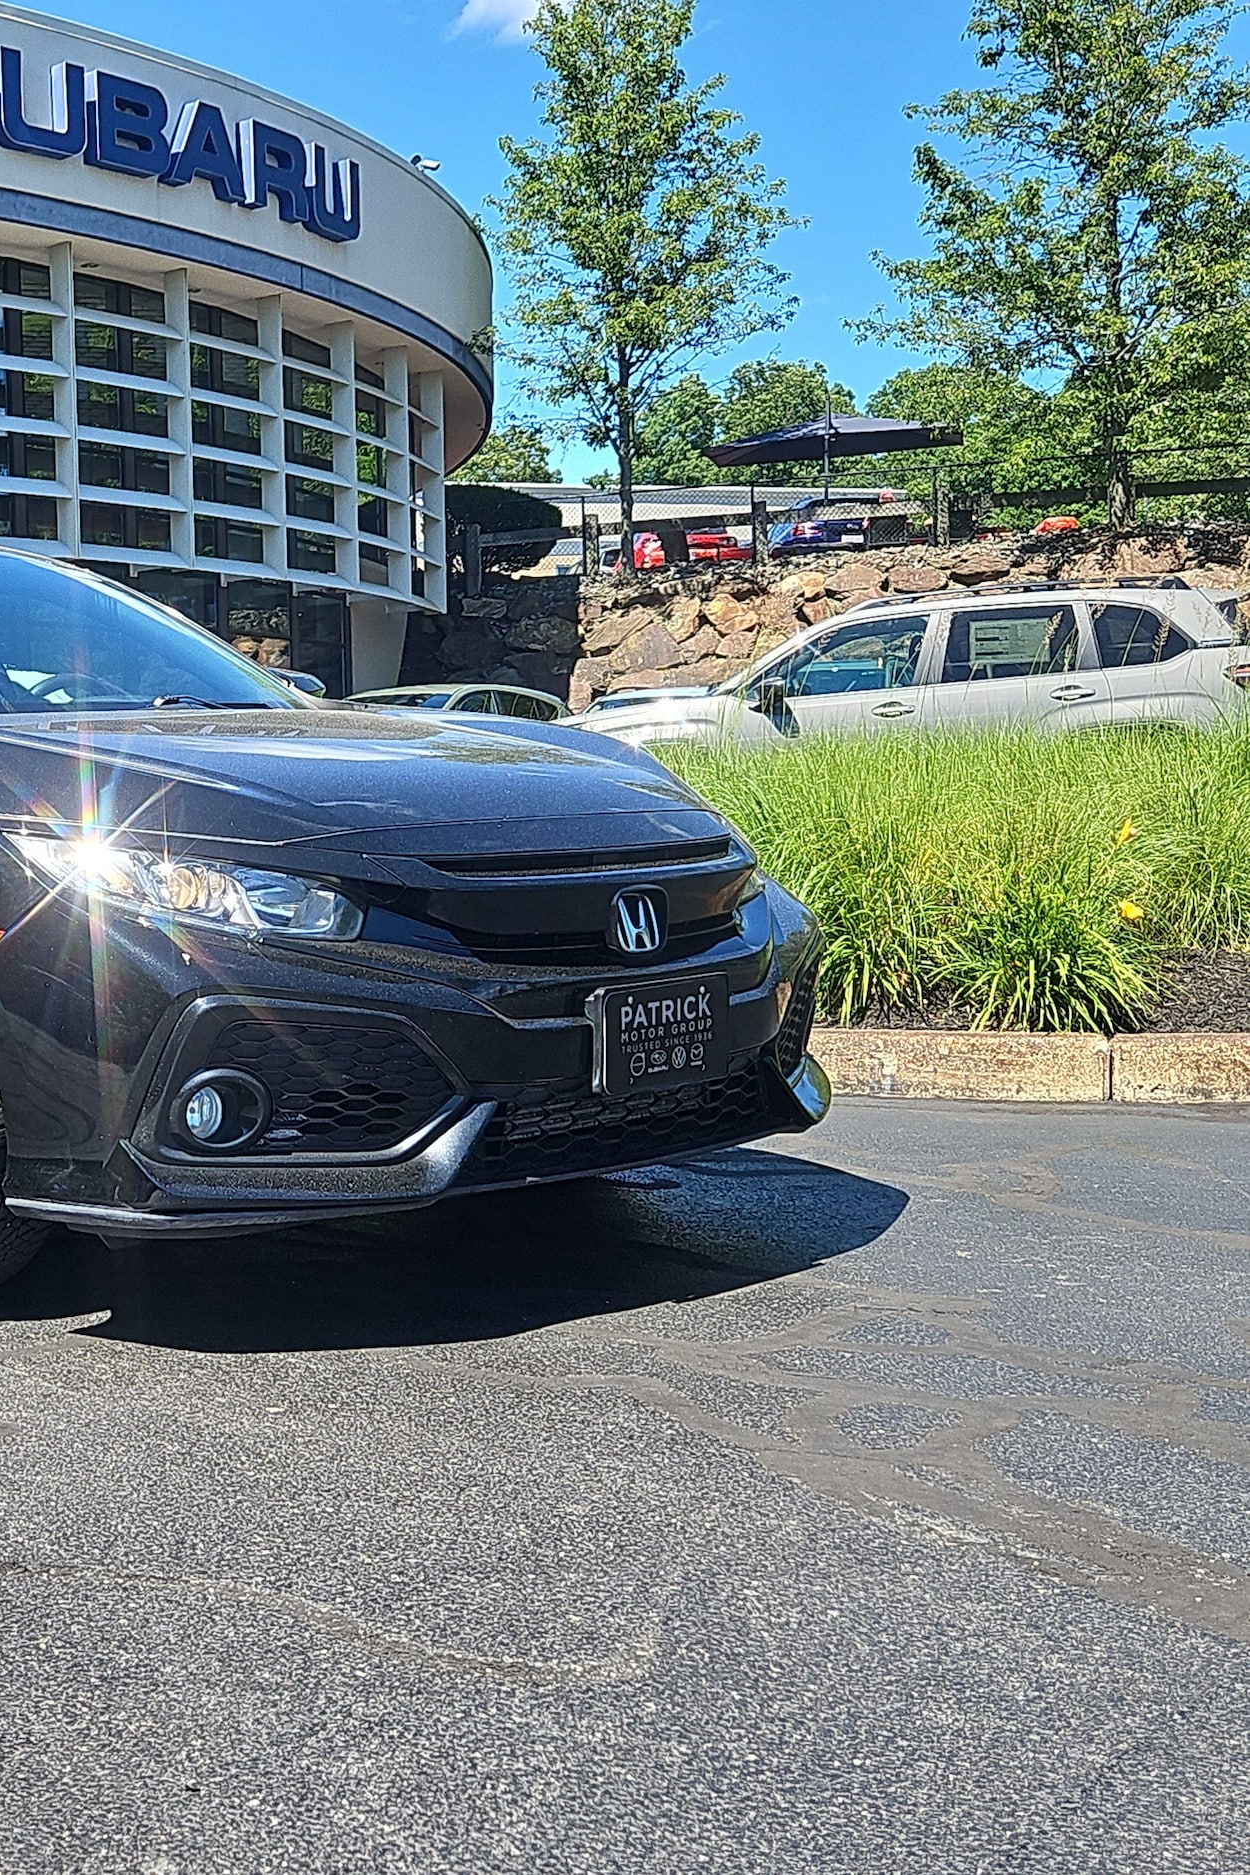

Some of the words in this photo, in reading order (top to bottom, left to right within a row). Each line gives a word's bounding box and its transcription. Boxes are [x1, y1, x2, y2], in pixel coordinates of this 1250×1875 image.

[620, 993, 712, 1031] PATRICK
[621, 1026, 665, 1043] MOTOR
[671, 1018, 713, 1035] GROUP
[621, 1040, 661, 1055] TRUSTED
[665, 1034, 690, 1048] SINCE
